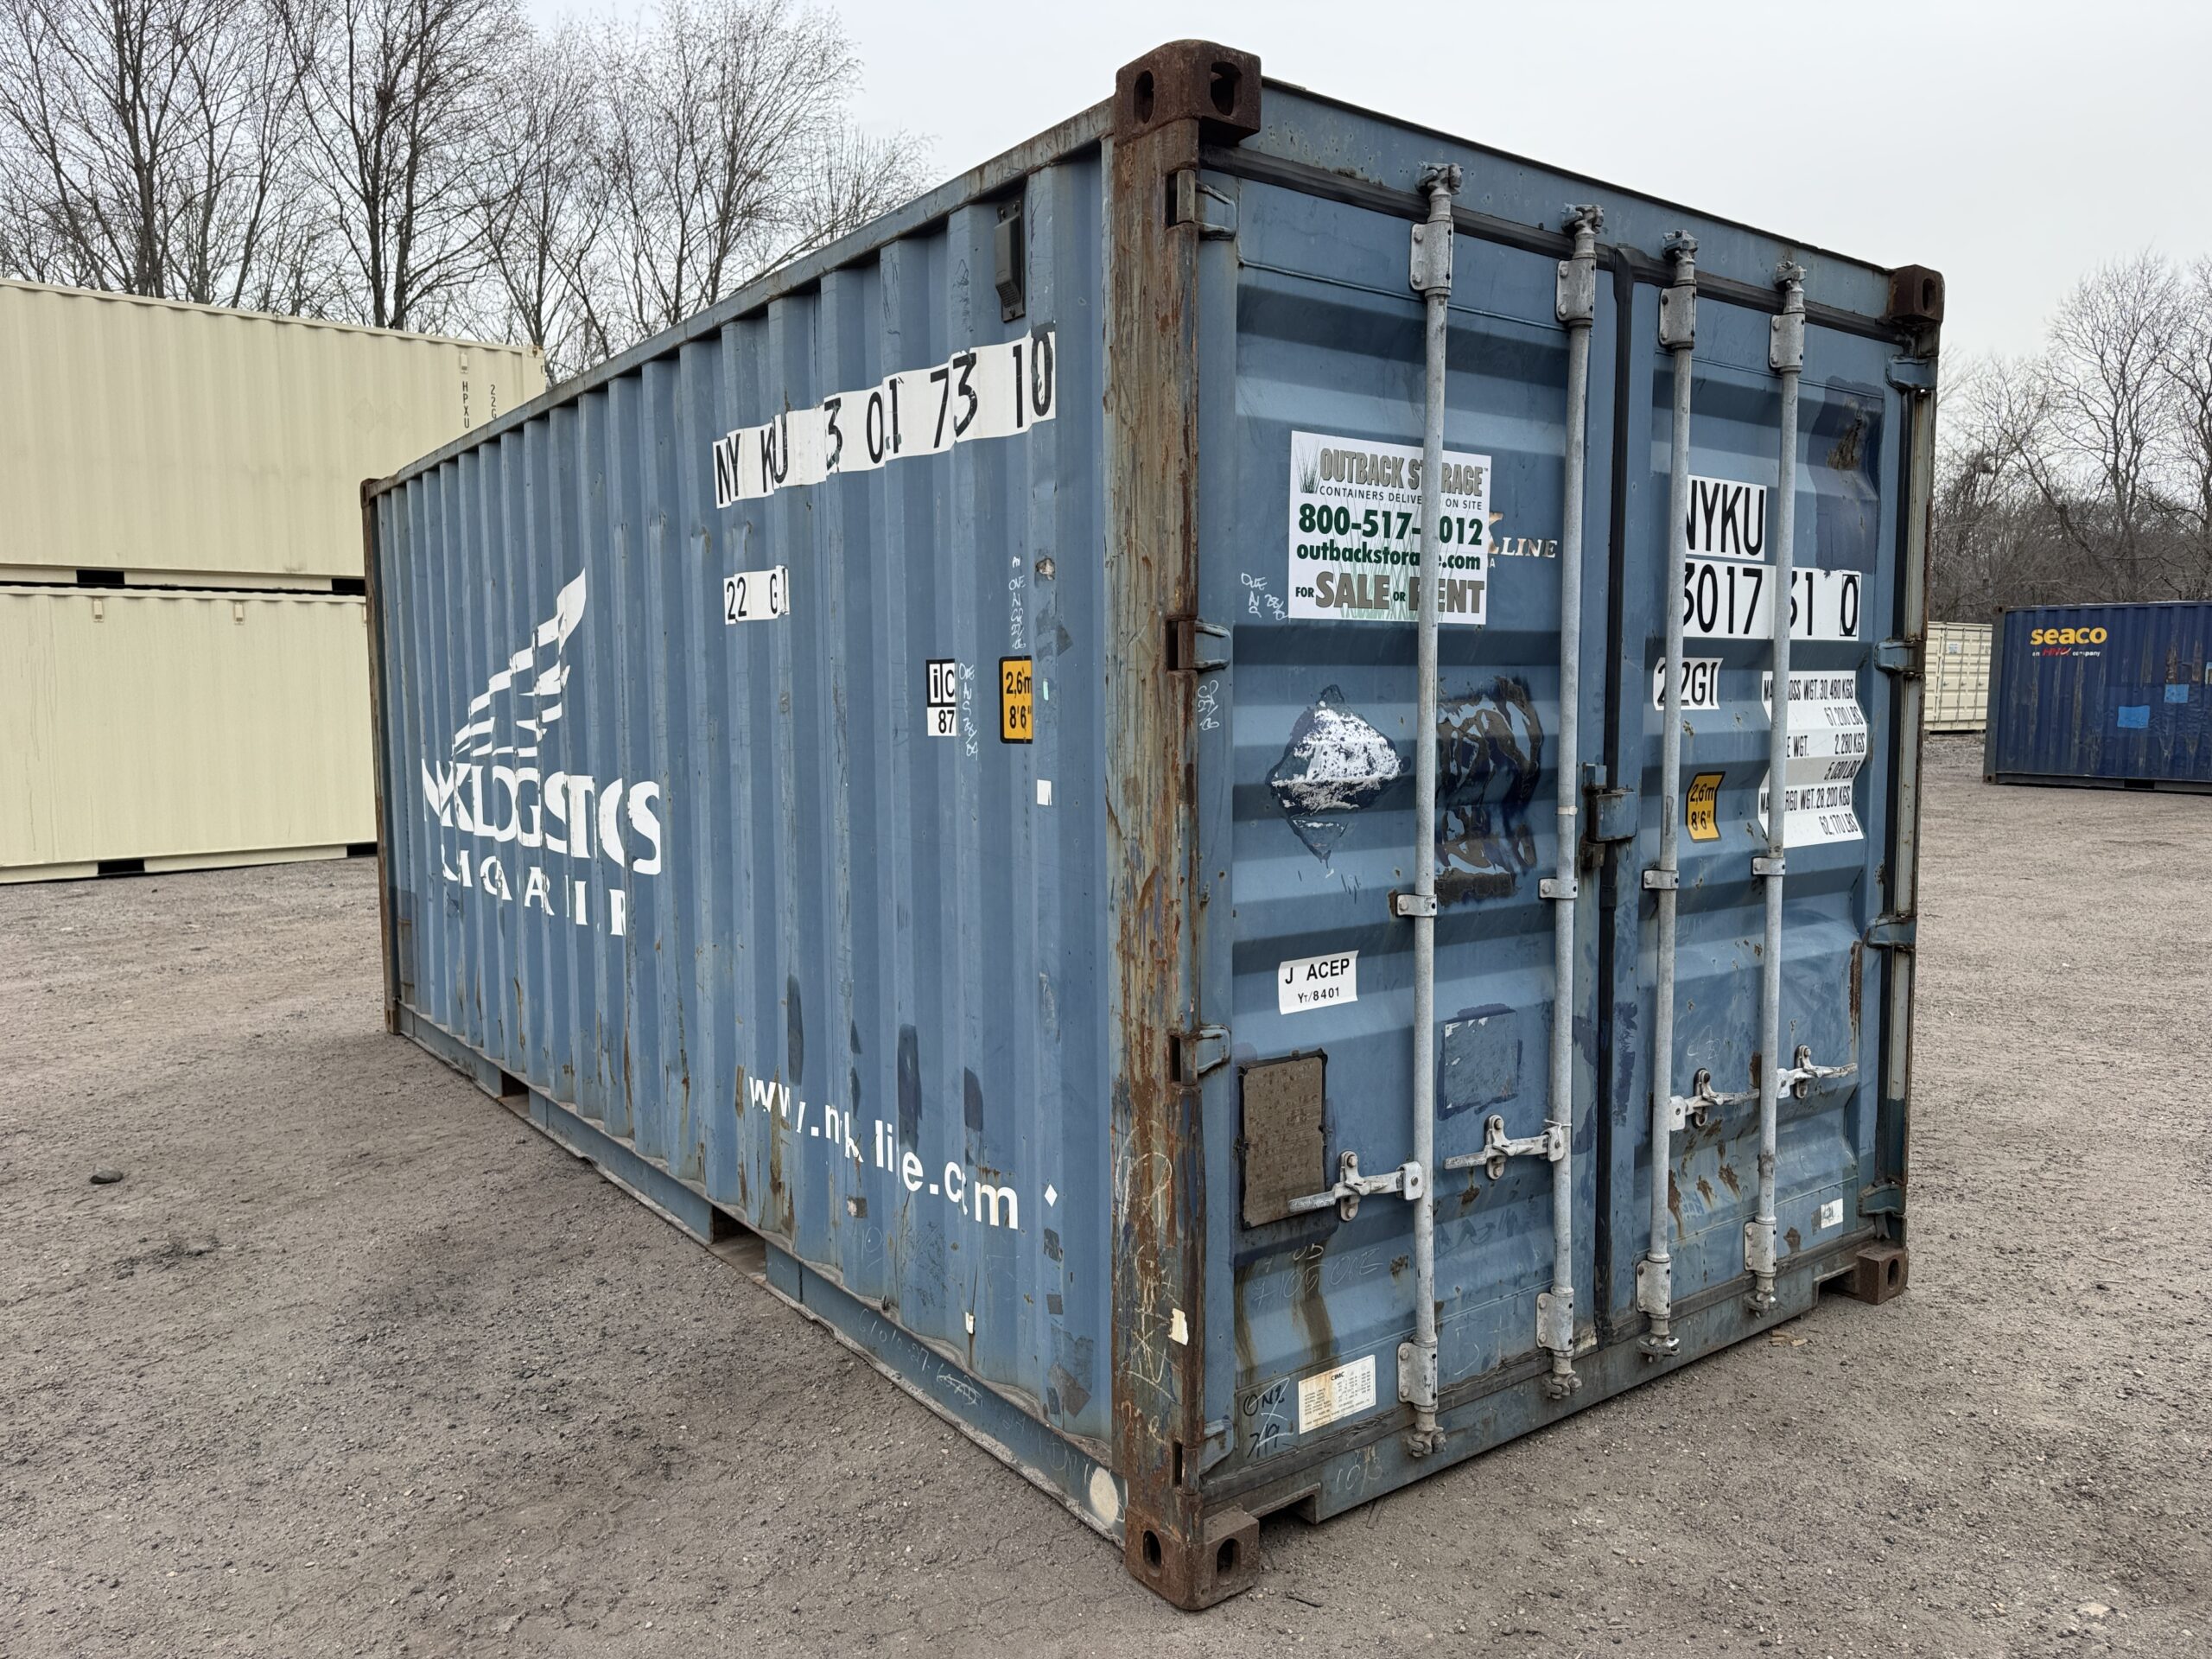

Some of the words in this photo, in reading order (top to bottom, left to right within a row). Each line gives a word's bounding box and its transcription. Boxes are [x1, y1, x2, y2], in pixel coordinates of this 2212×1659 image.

[1319, 448, 1405, 489] OUTBACK
[1408, 458, 1483, 497] SRAGE
[1319, 486, 1384, 501] CONTAINERS
[1445, 498, 1459, 508] ON
[1462, 500, 1483, 511] SITE
[1299, 503, 1484, 546] 800-517-012
[1296, 539, 1481, 570] outbackstora.com
[1295, 586, 1315, 598] FOR
[1315, 570, 1390, 610] SALE
[1393, 591, 1407, 601] OR
[2030, 626, 2107, 645] seaco
[938, 709, 955, 734] 87
[1689, 783, 1715, 806] 2,6m
[1285, 967, 1294, 984] J
[1306, 958, 1350, 981] ACEP
